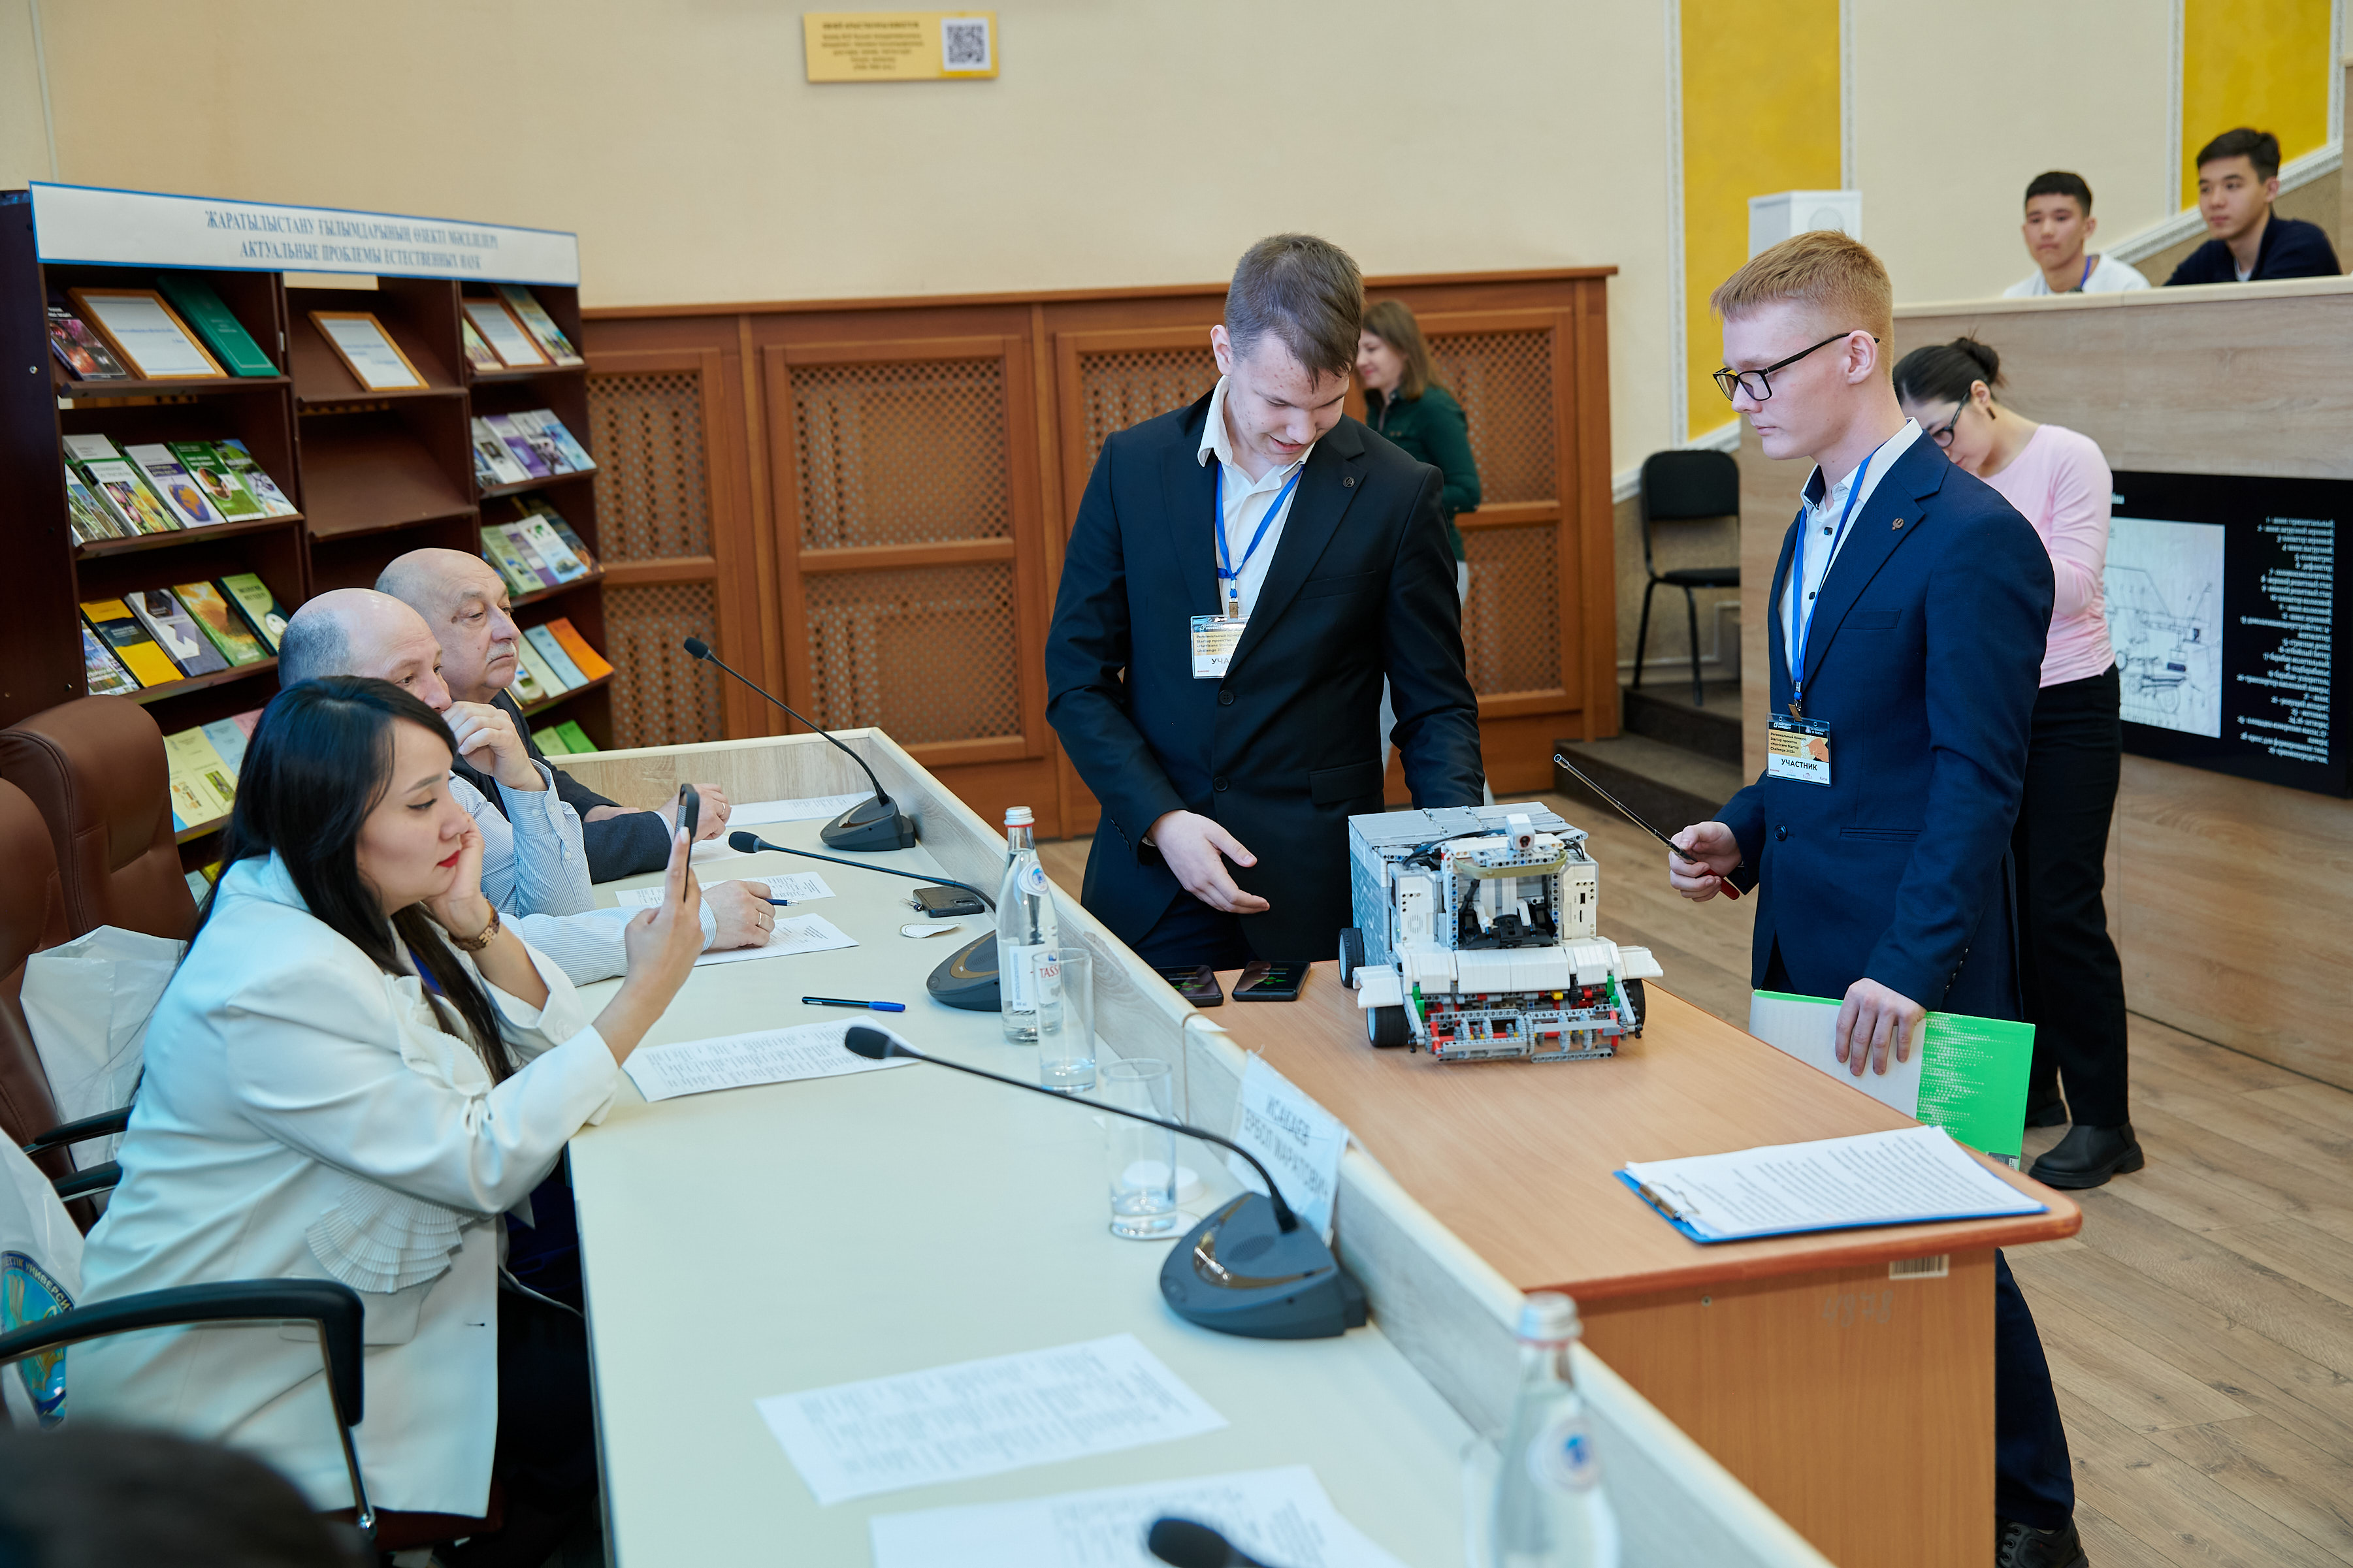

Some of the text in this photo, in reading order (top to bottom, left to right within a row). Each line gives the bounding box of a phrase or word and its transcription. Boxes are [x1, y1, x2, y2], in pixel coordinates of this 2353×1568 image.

[240, 240, 318, 261] АКТУАЛЬНЫЕ
[321, 244, 381, 264] ПРОБЛЕМЫ
[1781, 758, 1817, 771] УЧАСТНИК
